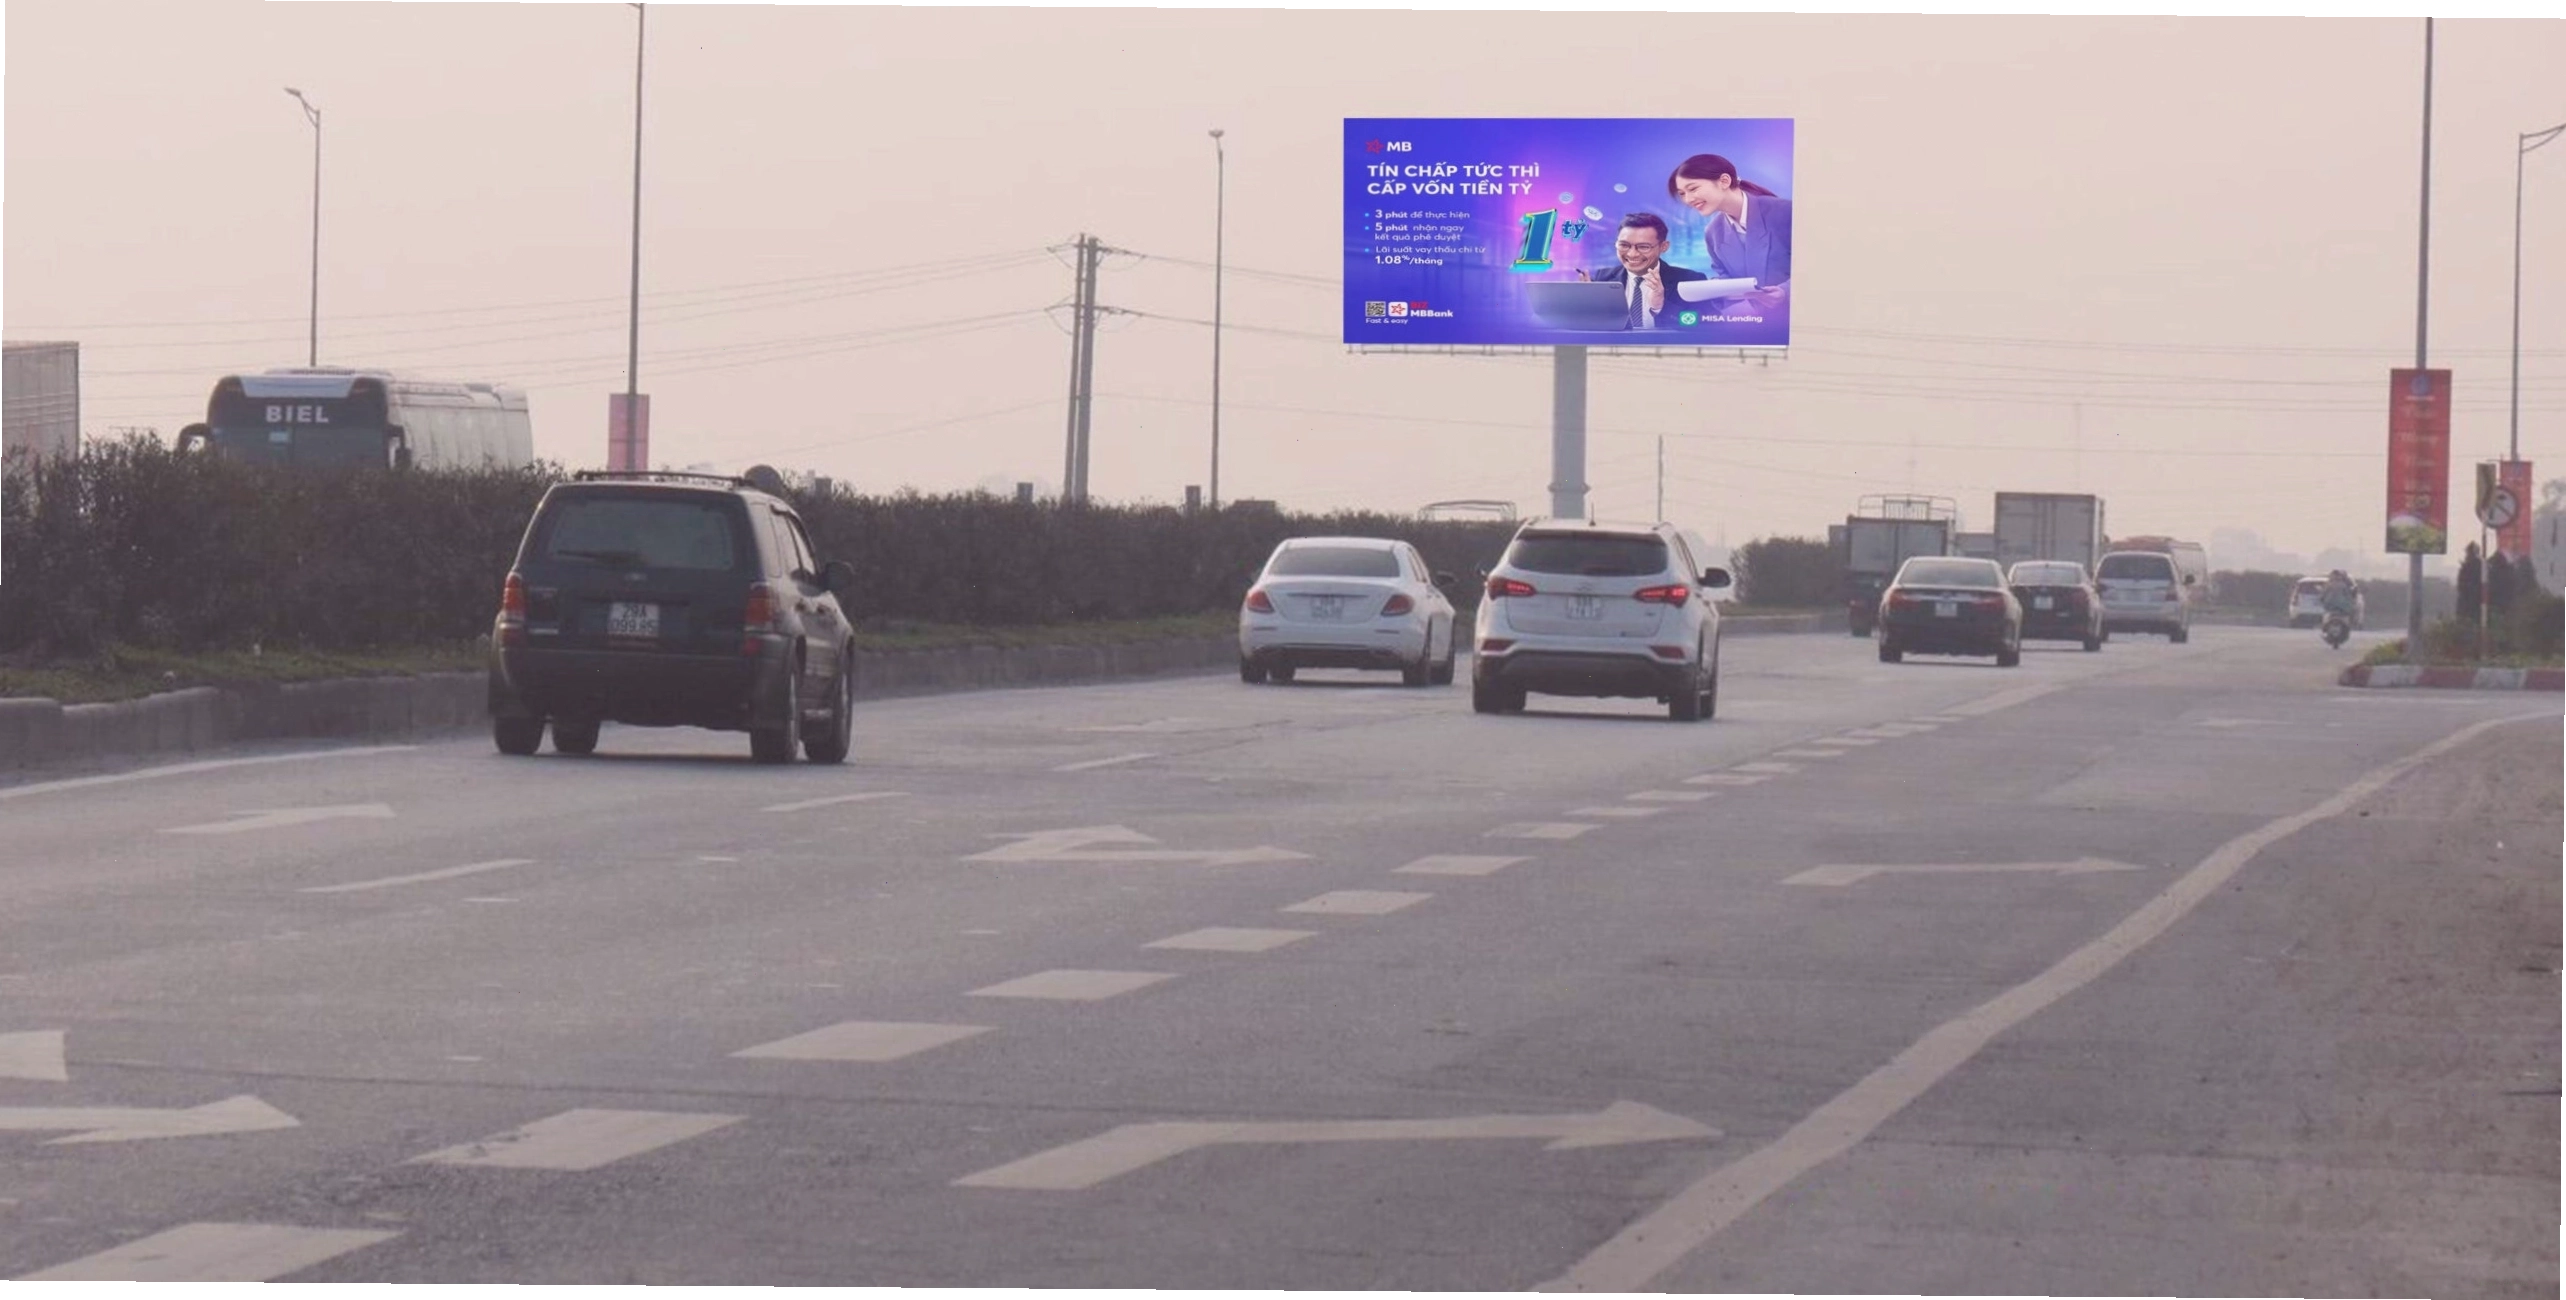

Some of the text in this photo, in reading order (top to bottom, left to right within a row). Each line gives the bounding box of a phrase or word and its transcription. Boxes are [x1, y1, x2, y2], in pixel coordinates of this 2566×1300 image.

[1386, 141, 1412, 152] MB
[1367, 161, 1540, 177] TÍN CHẤP TỨC THÌ
[1367, 179, 1533, 195] CẤP VỐN TIỀN TỶ
[1375, 209, 1383, 218] 3
[1385, 211, 1408, 219] phút
[1425, 211, 1447, 219] thực
[1449, 211, 1470, 220] hiện
[1375, 222, 1383, 231] 5
[1385, 224, 1408, 232] phút
[1413, 224, 1438, 232] nhận
[1374, 233, 1389, 241] kết
[1413, 233, 1432, 242] phê
[1434, 233, 1461, 242] duyệt
[1510, 208, 1557, 273] 1
[1410, 309, 1454, 318] MBBank
[1727, 315, 1763, 323] Lending
[266, 405, 330, 424] BIEL
